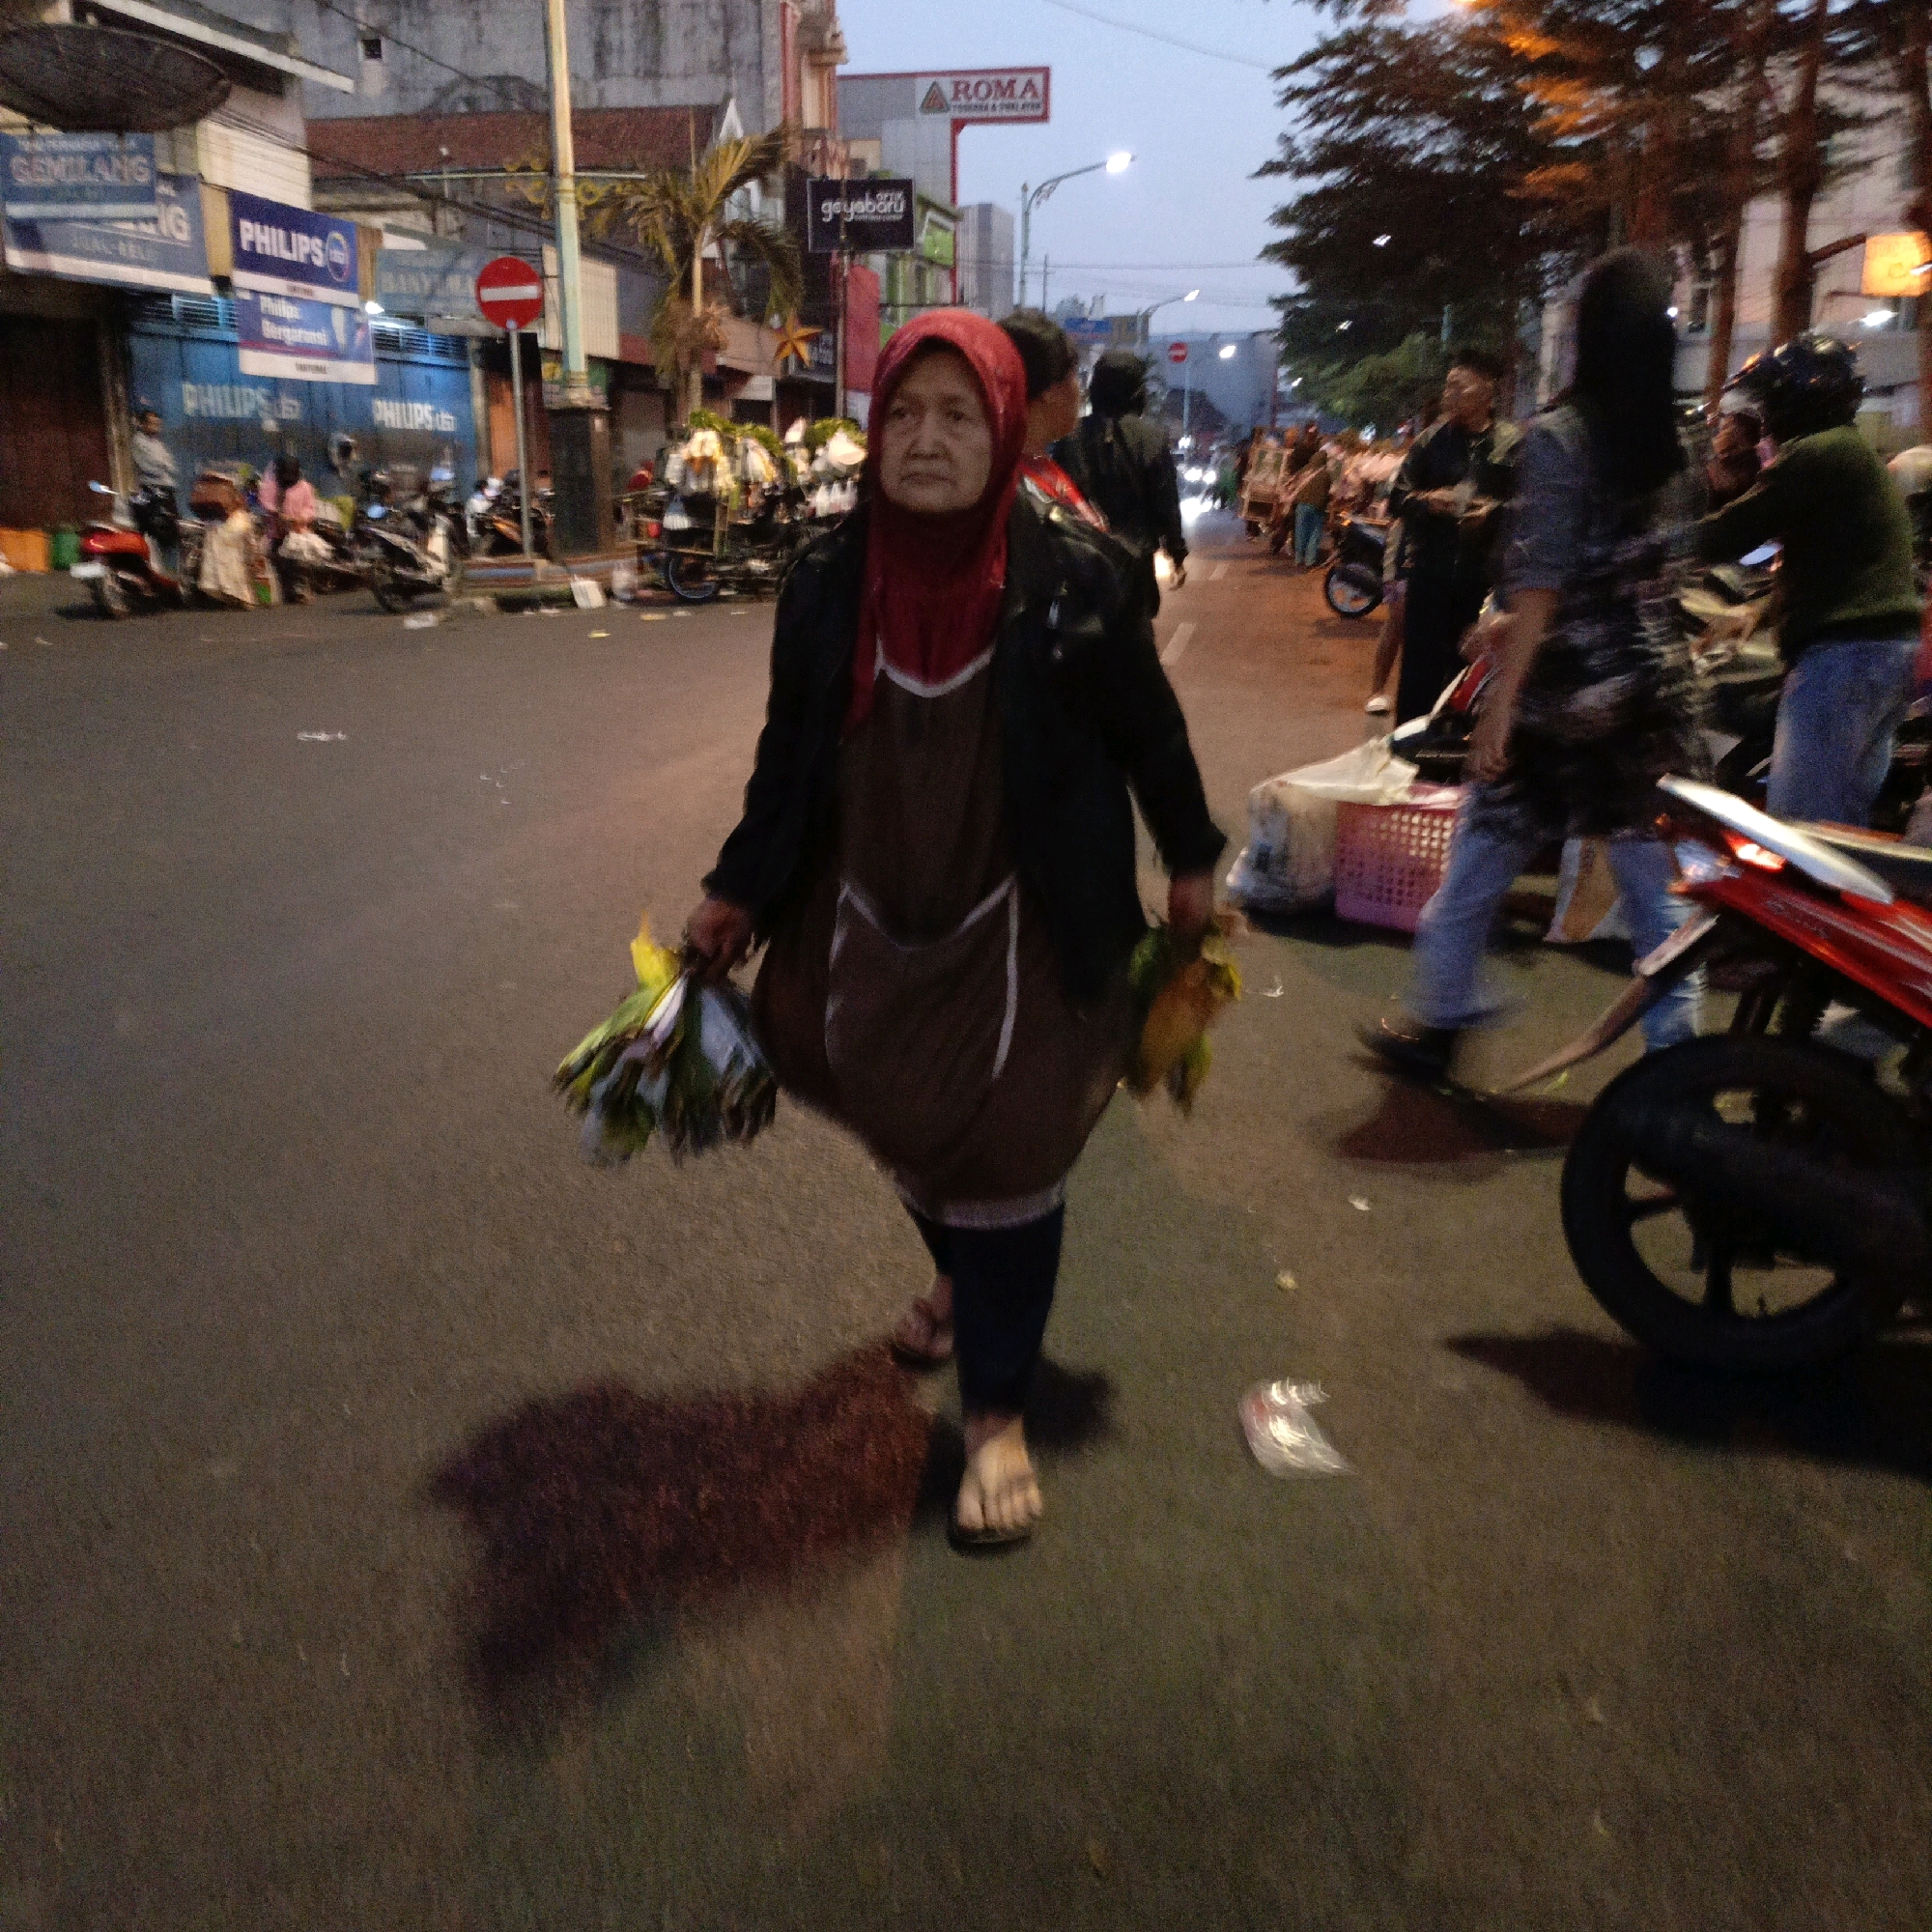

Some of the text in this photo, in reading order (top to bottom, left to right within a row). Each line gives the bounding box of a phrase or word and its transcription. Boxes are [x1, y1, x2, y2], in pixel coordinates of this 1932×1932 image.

[952, 79, 1040, 100] ROMA
[10, 155, 151, 185] GEMILANG
[240, 218, 327, 268] PHILIPS
[183, 383, 271, 418] PHILIPS
[373, 397, 434, 431] PHILIPS
